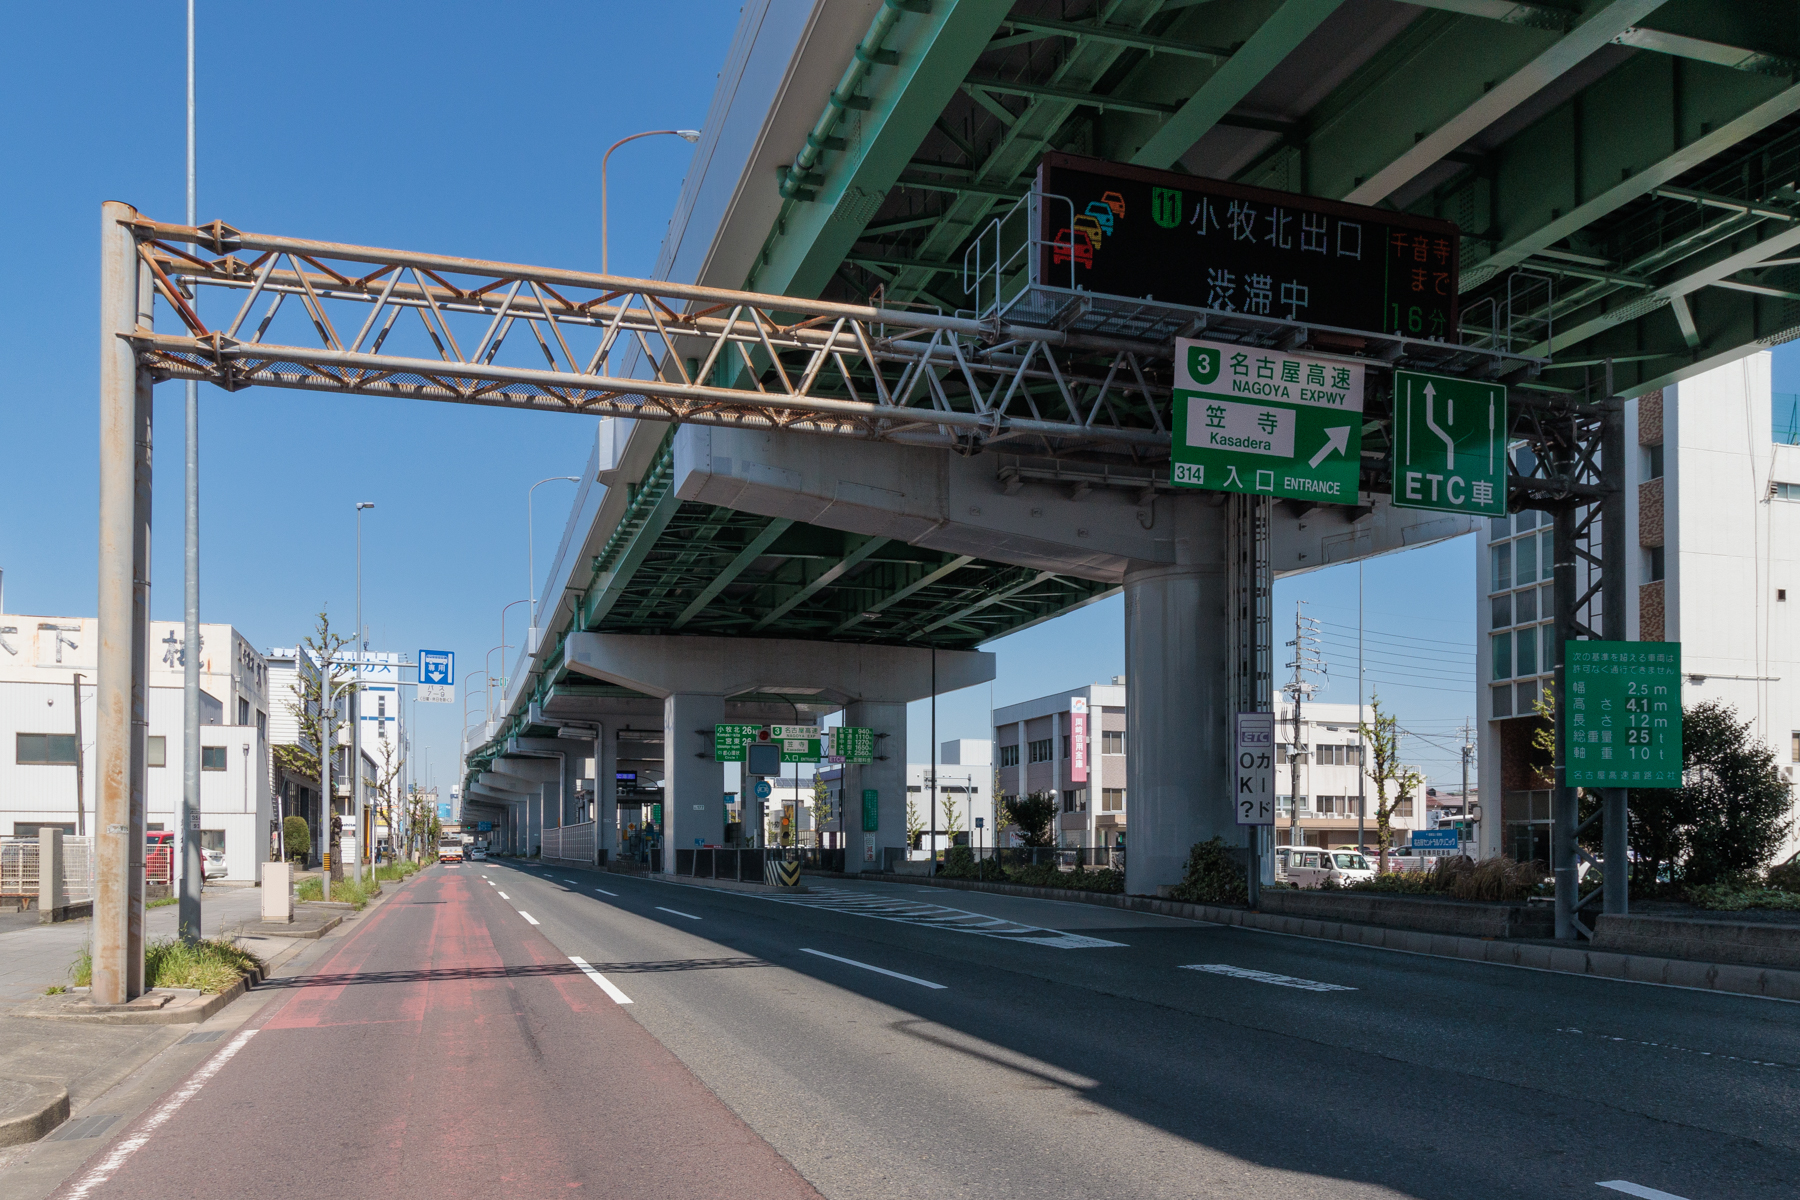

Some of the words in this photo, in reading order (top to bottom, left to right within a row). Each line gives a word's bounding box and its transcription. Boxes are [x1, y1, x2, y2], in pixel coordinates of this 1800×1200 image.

[1156, 193, 1178, 223] 11
[1189, 197, 1363, 261] 小牧北出口
[1389, 232, 1451, 266] 千音寺
[1207, 268, 1310, 320] 渋滞中
[1410, 267, 1450, 296] まで
[1197, 354, 1211, 375] 3
[1229, 352, 1352, 390] 名古屋高速
[1232, 379, 1290, 399] NAGOYA
[1300, 388, 1347, 406] EXPWY
[1205, 405, 1279, 436] 笠寺
[1210, 432, 1272, 451] Kasadera
[1176, 464, 1202, 484] 314
[1223, 466, 1275, 492] 入口
[1284, 477, 1341, 496] ENTRANCE
[1405, 471, 1494, 507] ETC車
[1572, 652, 1674, 663] 次の基準を超える車両は
[1572, 664, 1674, 675] 許可なく通行できません
[1573, 681, 1585, 694] 幅
[1628, 682, 1648, 695] 2.5
[1654, 686, 1667, 695] m
[1626, 699, 1648, 712] 4.1
[1654, 702, 1667, 711] m
[742, 726, 752, 734] 26
[1629, 715, 1650, 727] 12
[1654, 718, 1667, 727] m
[1243, 732, 1269, 742] ETC
[1573, 730, 1613, 743] 総重量
[1628, 730, 1649, 743] 25
[1629, 747, 1650, 760] 10
[1240, 752, 1254, 818] OK?
[1257, 752, 1270, 818] カード
[1573, 771, 1676, 780] 名古屋高速道路公社
